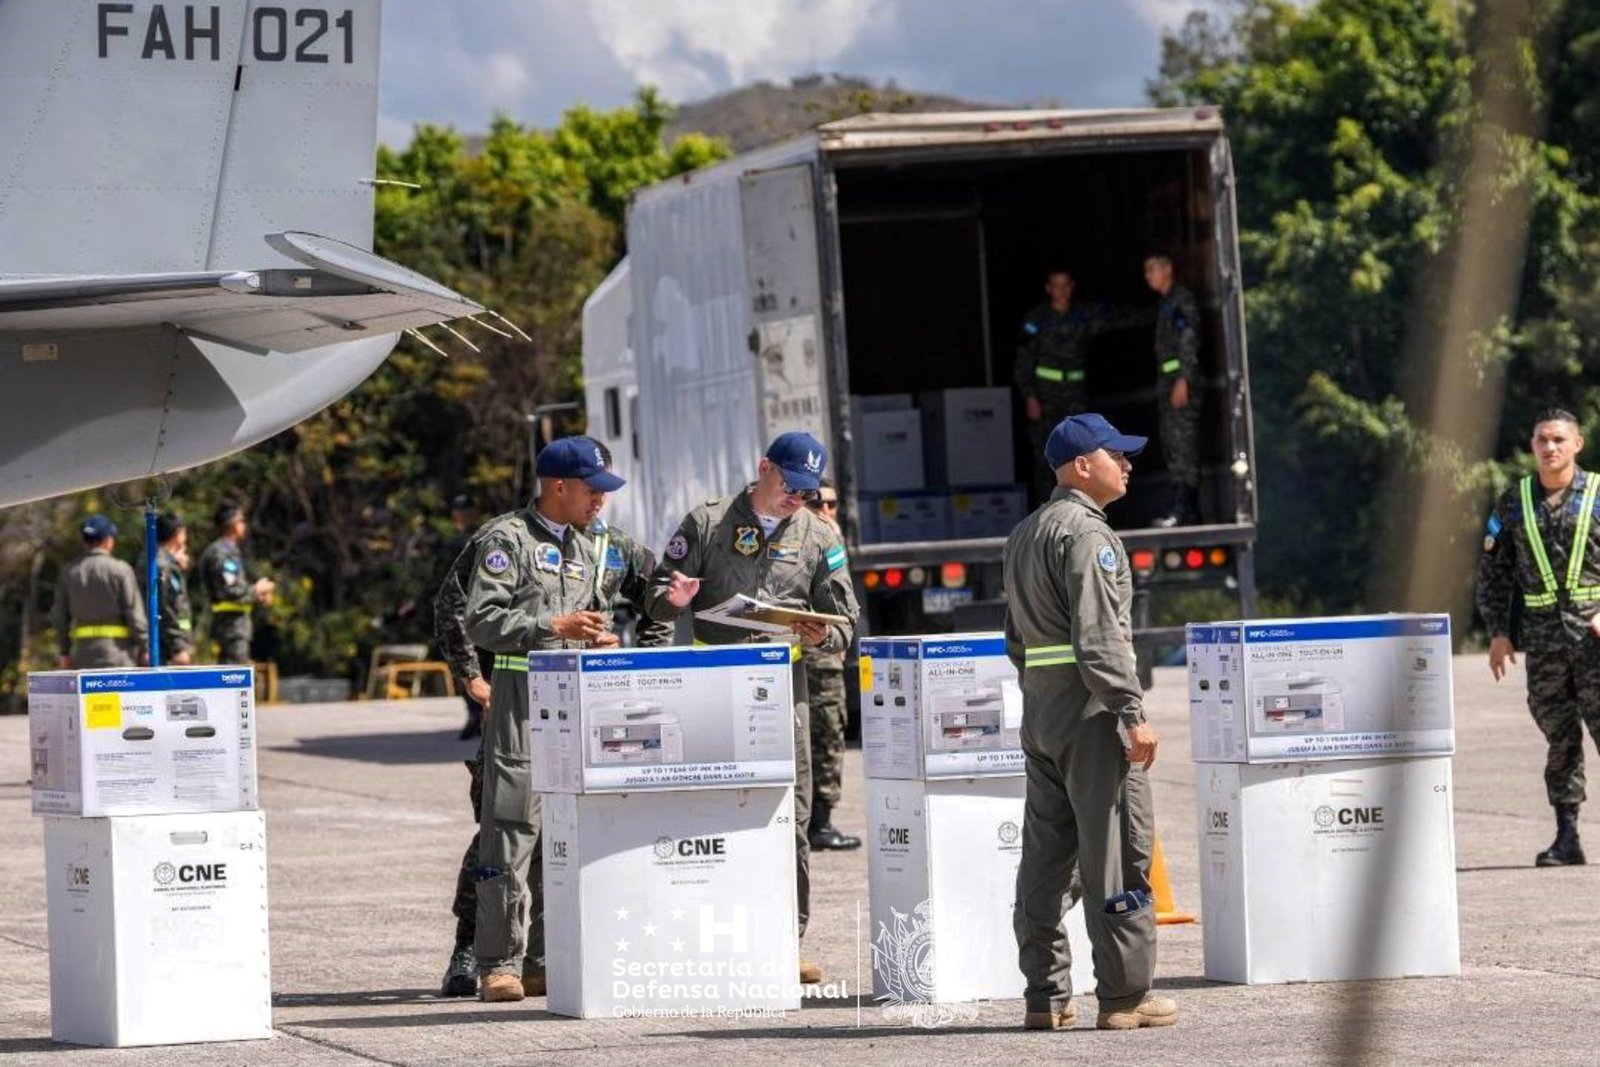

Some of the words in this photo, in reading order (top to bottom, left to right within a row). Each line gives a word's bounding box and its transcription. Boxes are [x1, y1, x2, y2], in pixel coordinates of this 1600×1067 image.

[97, 3, 220, 61] FAH
[253, 7, 353, 63] 021
[928, 668, 975, 676] ALL-IN-ONE
[1433, 785, 1447, 793] C-3
[776, 816, 789, 824] C-3
[1212, 811, 1228, 828] CNE
[1338, 806, 1384, 825] CNE
[888, 828, 909, 845] CNE
[553, 841, 567, 858] CNE
[678, 838, 726, 856] CNE
[73, 867, 90, 885] CNE
[179, 864, 227, 882] CNE
